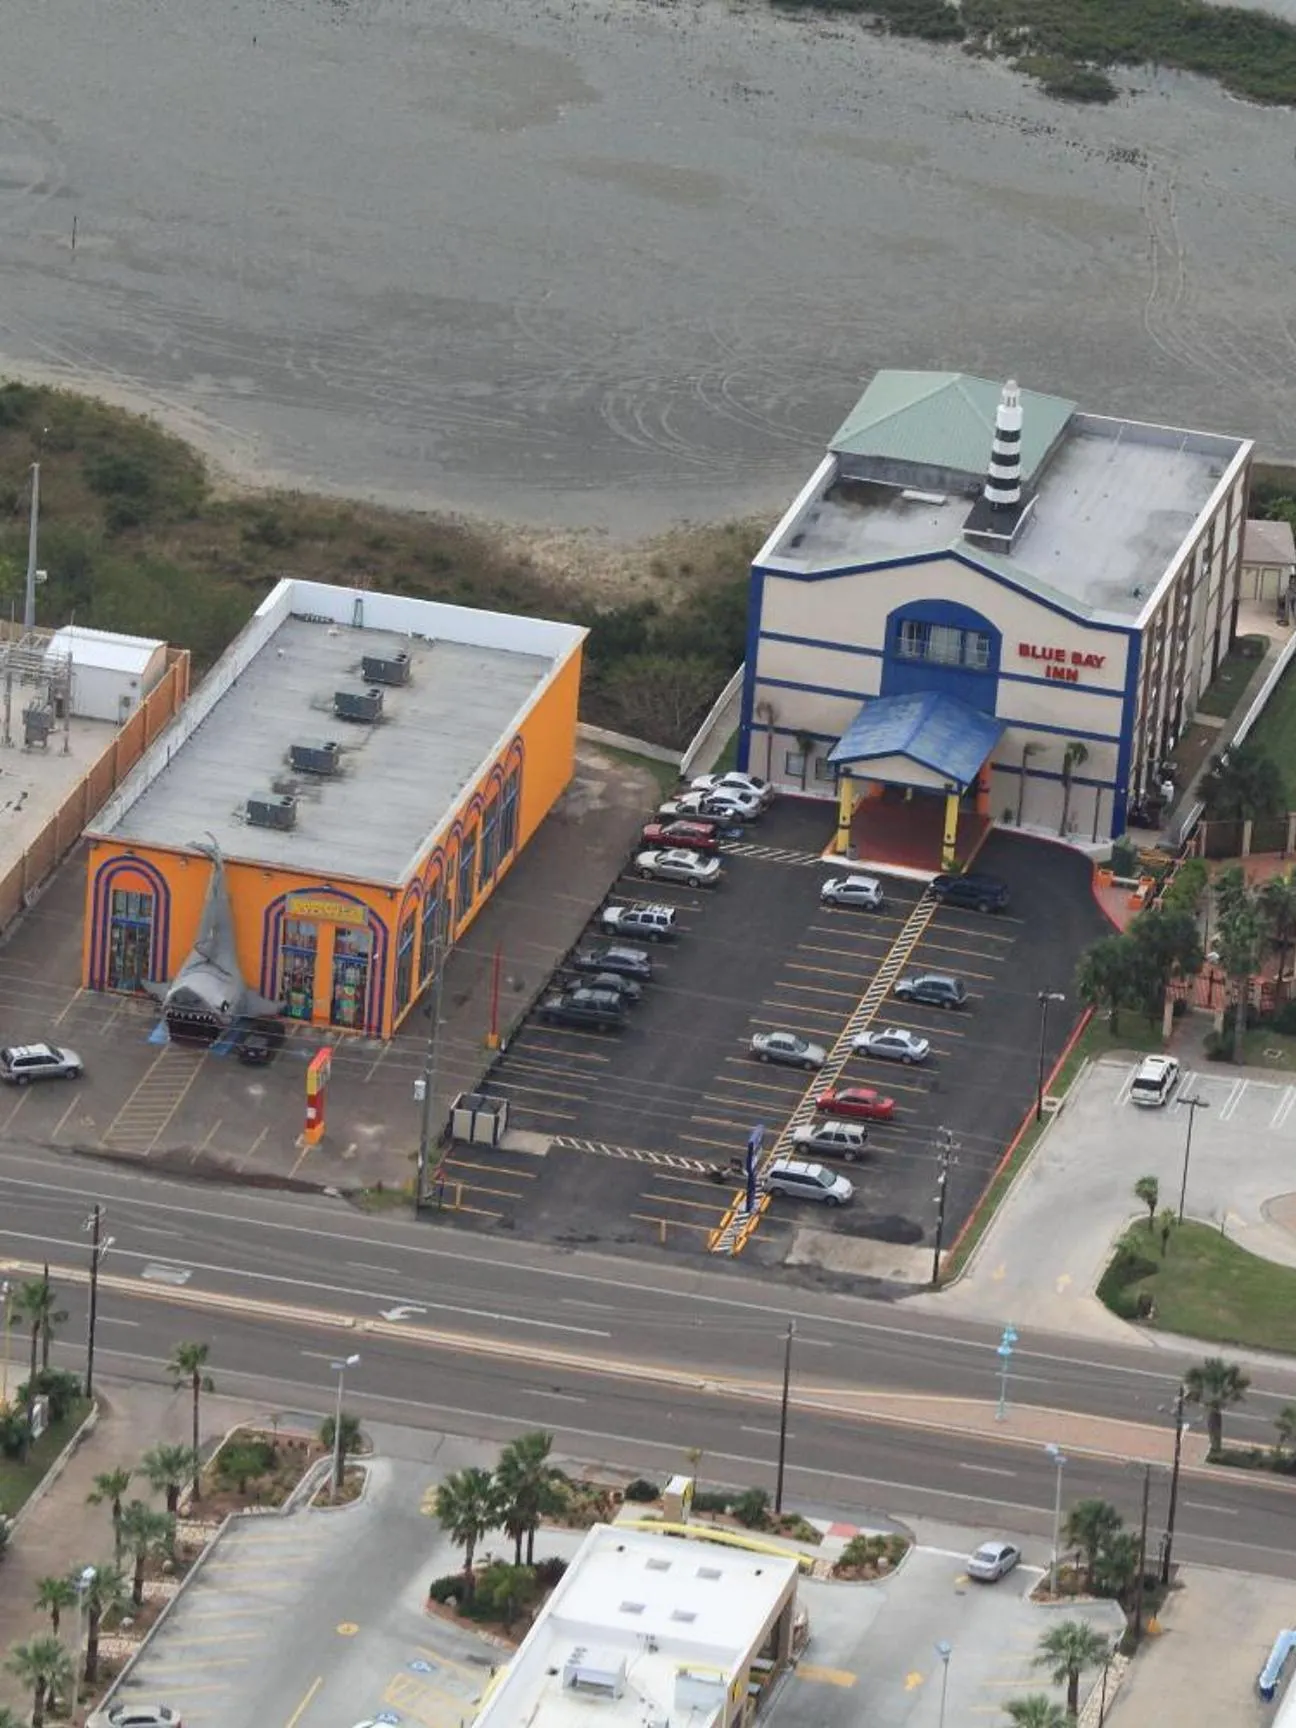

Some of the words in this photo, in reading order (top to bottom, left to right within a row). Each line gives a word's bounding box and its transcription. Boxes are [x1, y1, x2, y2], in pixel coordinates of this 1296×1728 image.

[1018, 642, 1066, 663] BLUE
[1071, 651, 1106, 668] BAY
[1045, 665, 1079, 682] INN
